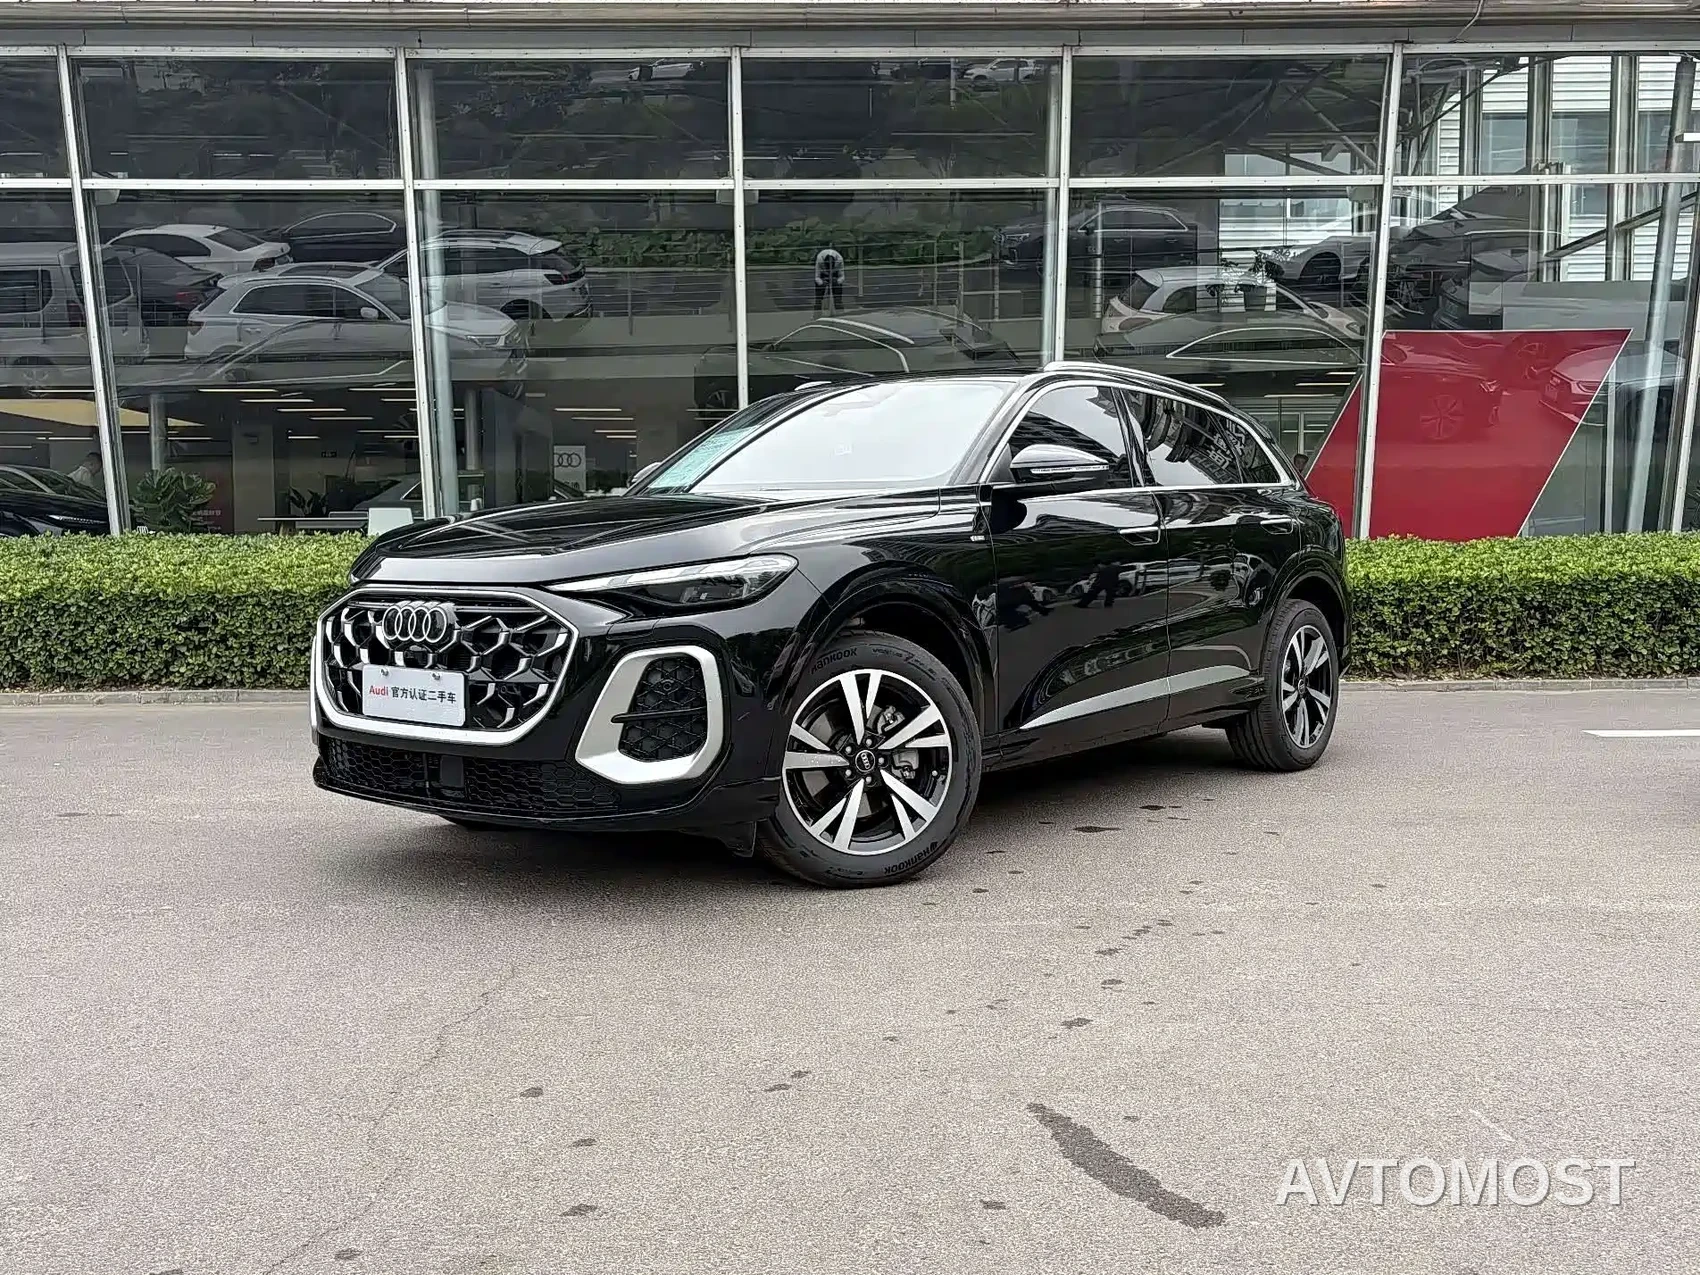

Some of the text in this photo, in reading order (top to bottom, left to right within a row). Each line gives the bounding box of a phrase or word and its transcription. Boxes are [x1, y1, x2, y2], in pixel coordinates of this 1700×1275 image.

[369, 685, 457, 703] Audi 官方认证二手车
